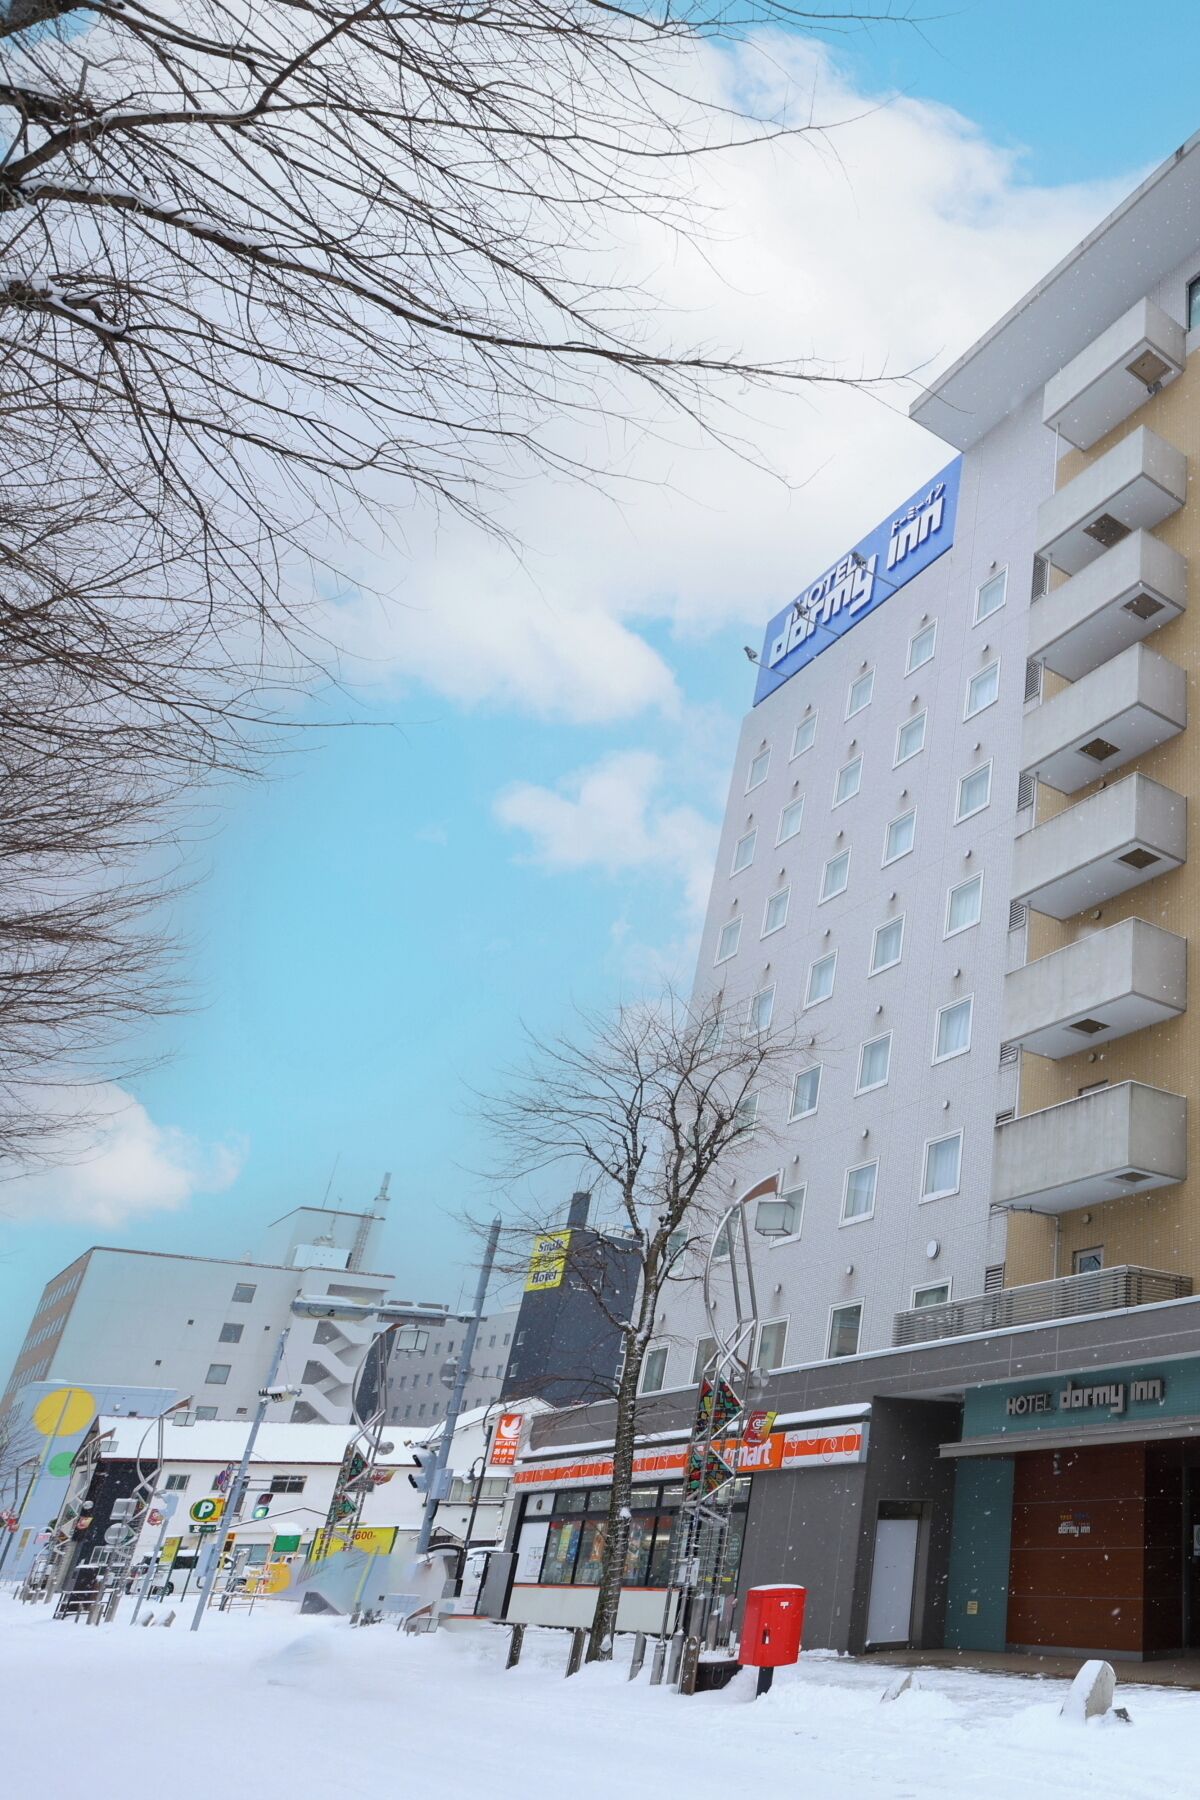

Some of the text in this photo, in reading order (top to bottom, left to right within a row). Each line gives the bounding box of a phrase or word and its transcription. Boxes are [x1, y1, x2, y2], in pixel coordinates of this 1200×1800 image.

[768, 496, 945, 668] dormy inn
[1006, 1379, 1162, 1415] HOTEL dormy inn
[197, 1501, 214, 1518] P
